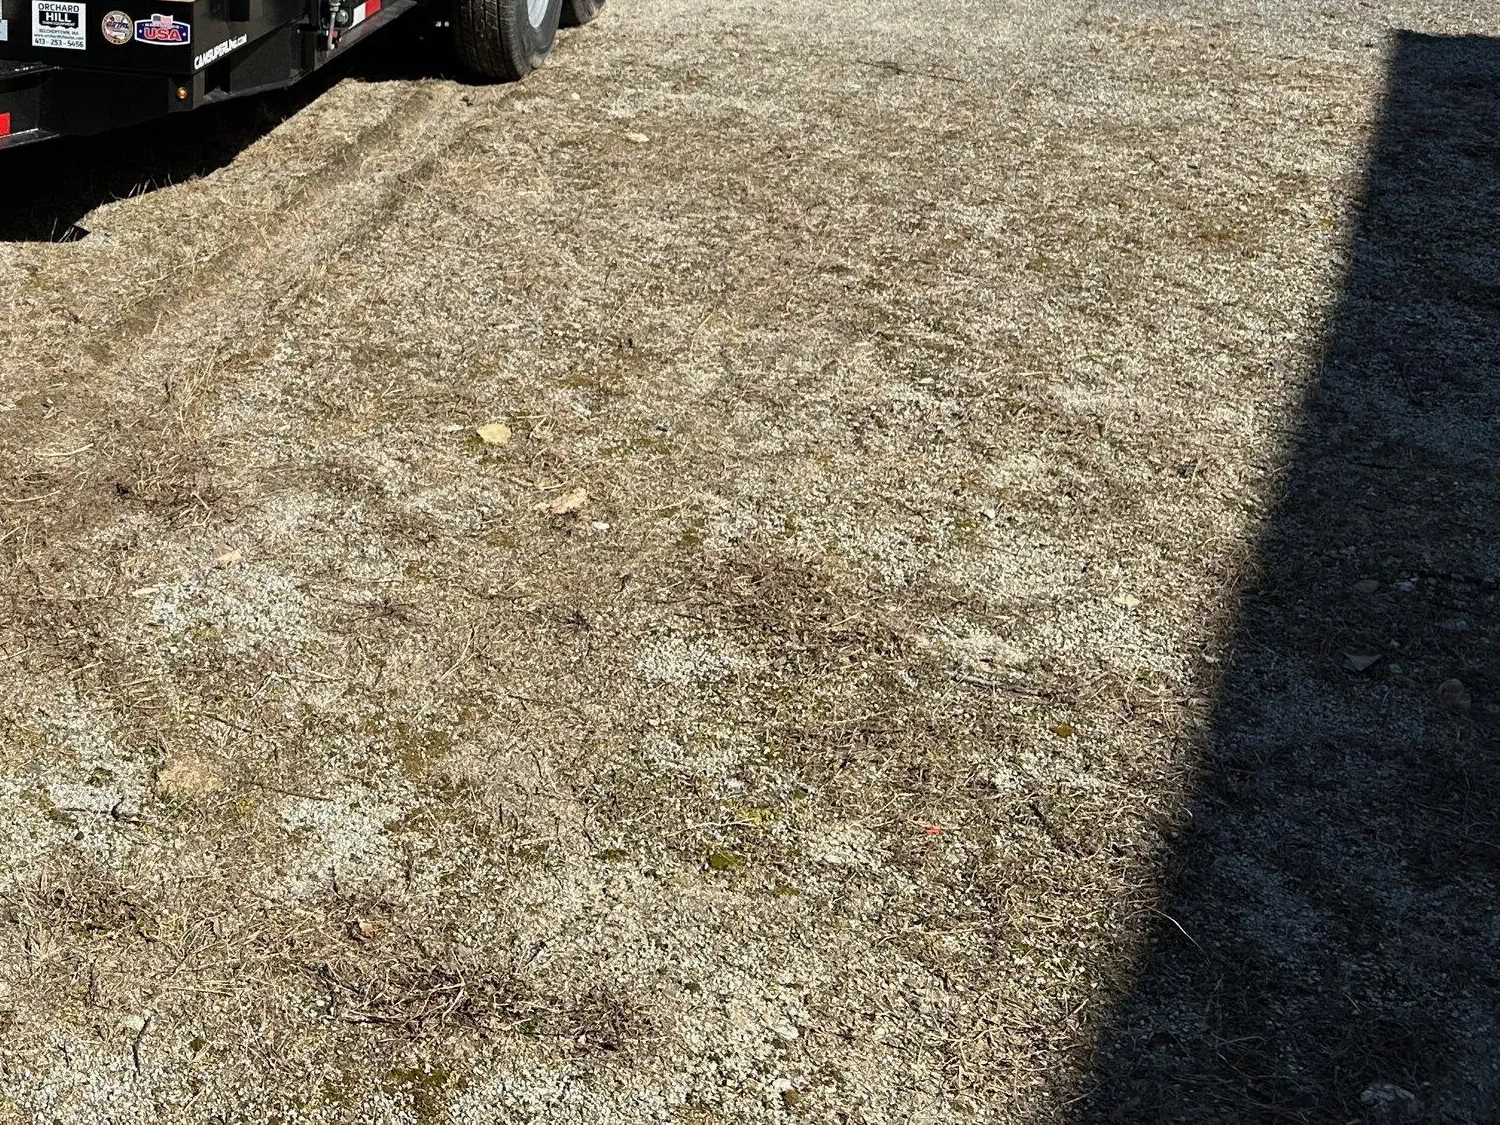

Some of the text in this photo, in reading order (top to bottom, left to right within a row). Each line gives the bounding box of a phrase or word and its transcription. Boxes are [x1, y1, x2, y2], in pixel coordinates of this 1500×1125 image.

[38, 2, 79, 13] ORCHARD
[45, 12, 71, 22] HILL
[144, 27, 182, 42] USA
